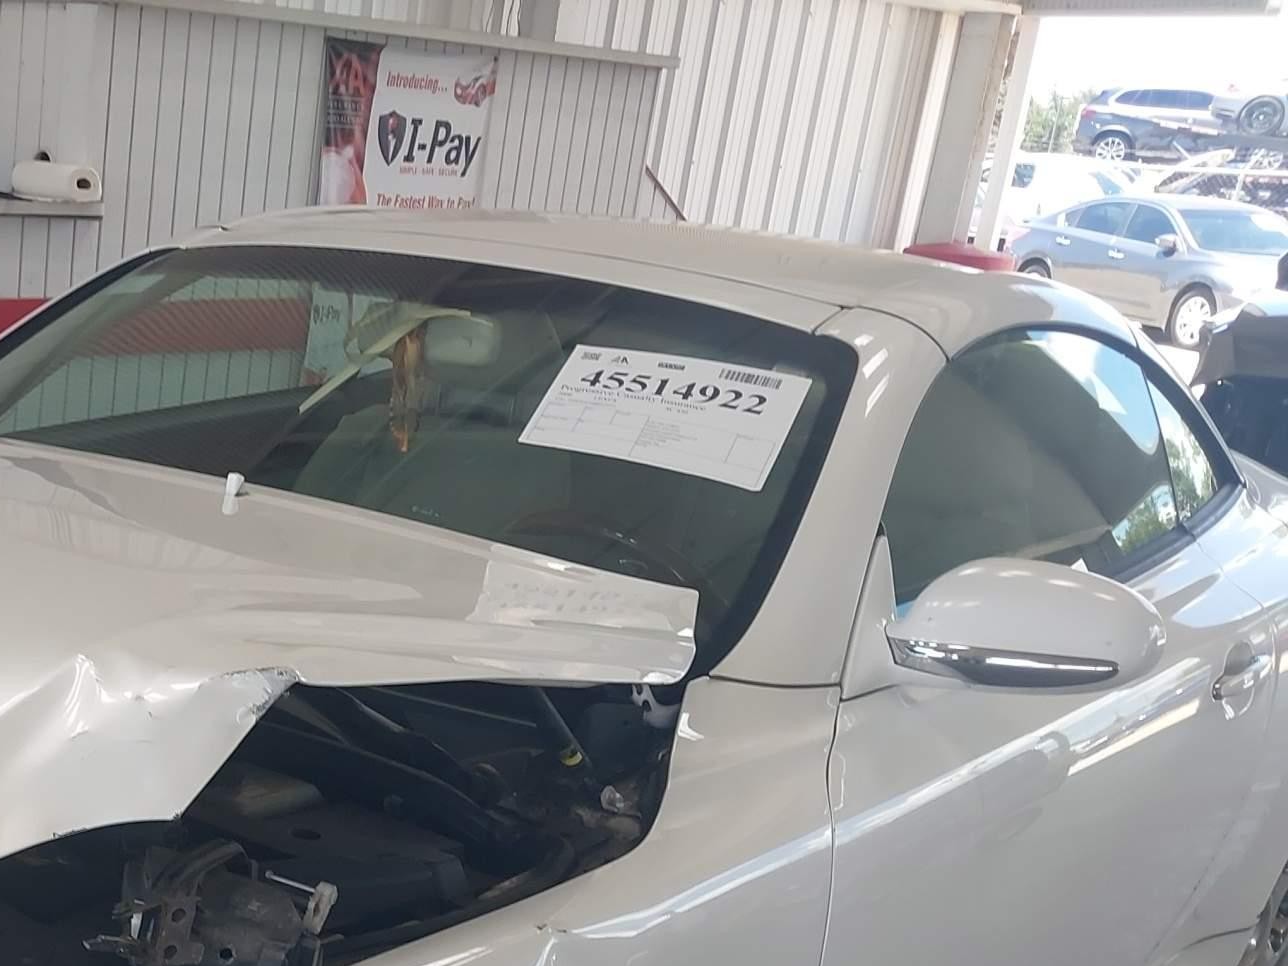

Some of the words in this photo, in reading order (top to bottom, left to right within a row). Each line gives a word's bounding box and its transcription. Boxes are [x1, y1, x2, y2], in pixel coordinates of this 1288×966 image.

[386, 71, 448, 93] Introducing...
[403, 118, 481, 177] I-Pay
[377, 193, 392, 206] The
[394, 194, 425, 209] Fastest
[581, 368, 768, 415] 45514922
